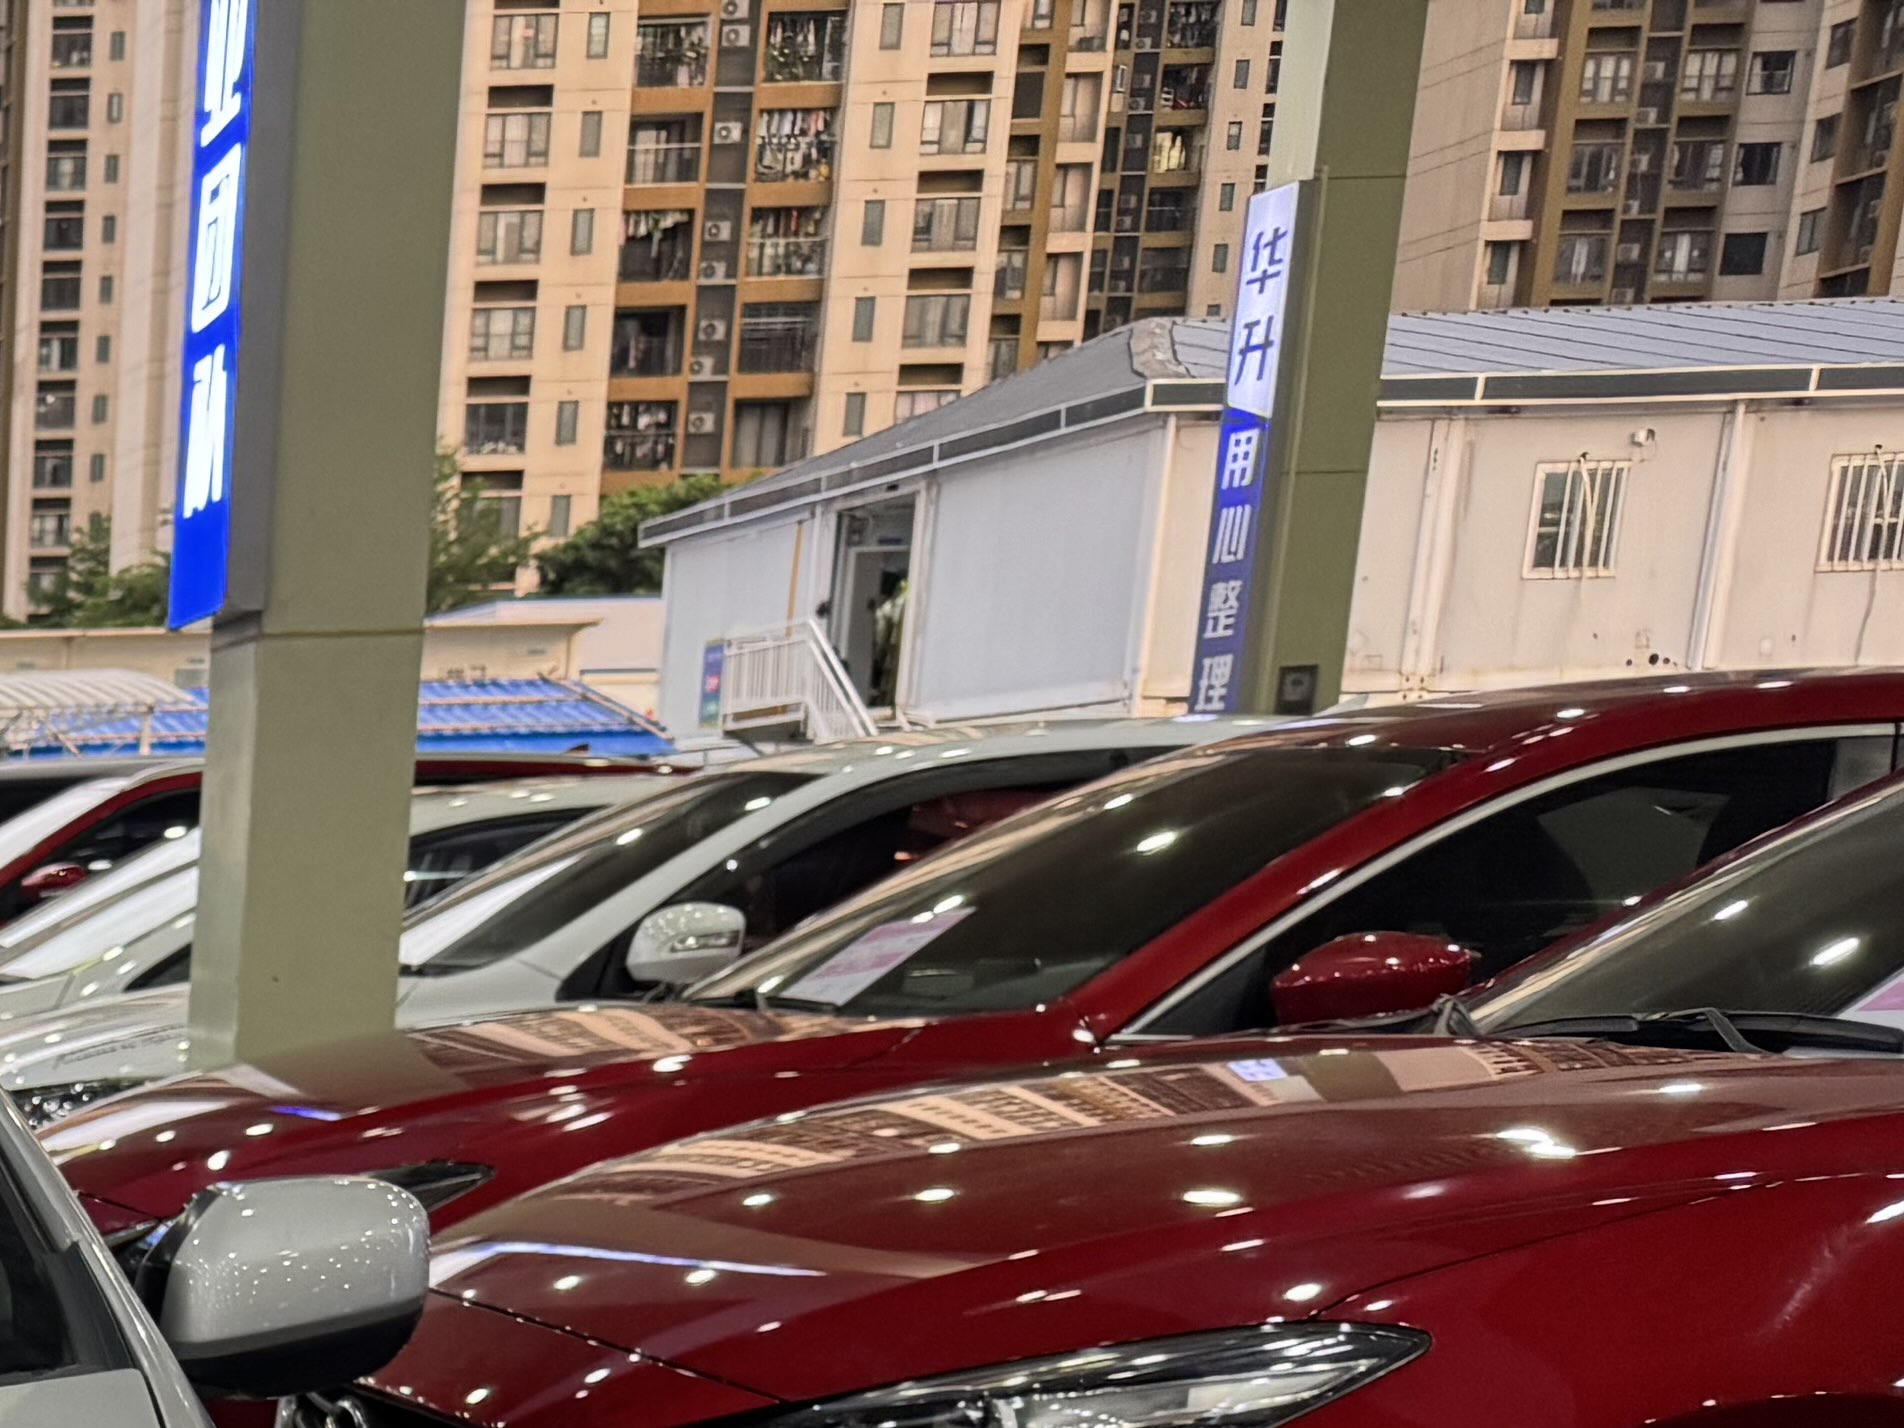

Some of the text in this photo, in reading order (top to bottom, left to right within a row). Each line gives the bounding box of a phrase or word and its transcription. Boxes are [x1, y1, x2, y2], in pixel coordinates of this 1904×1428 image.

[1234, 227, 1289, 386] 华升
[1194, 430, 1260, 713] 用心整理
